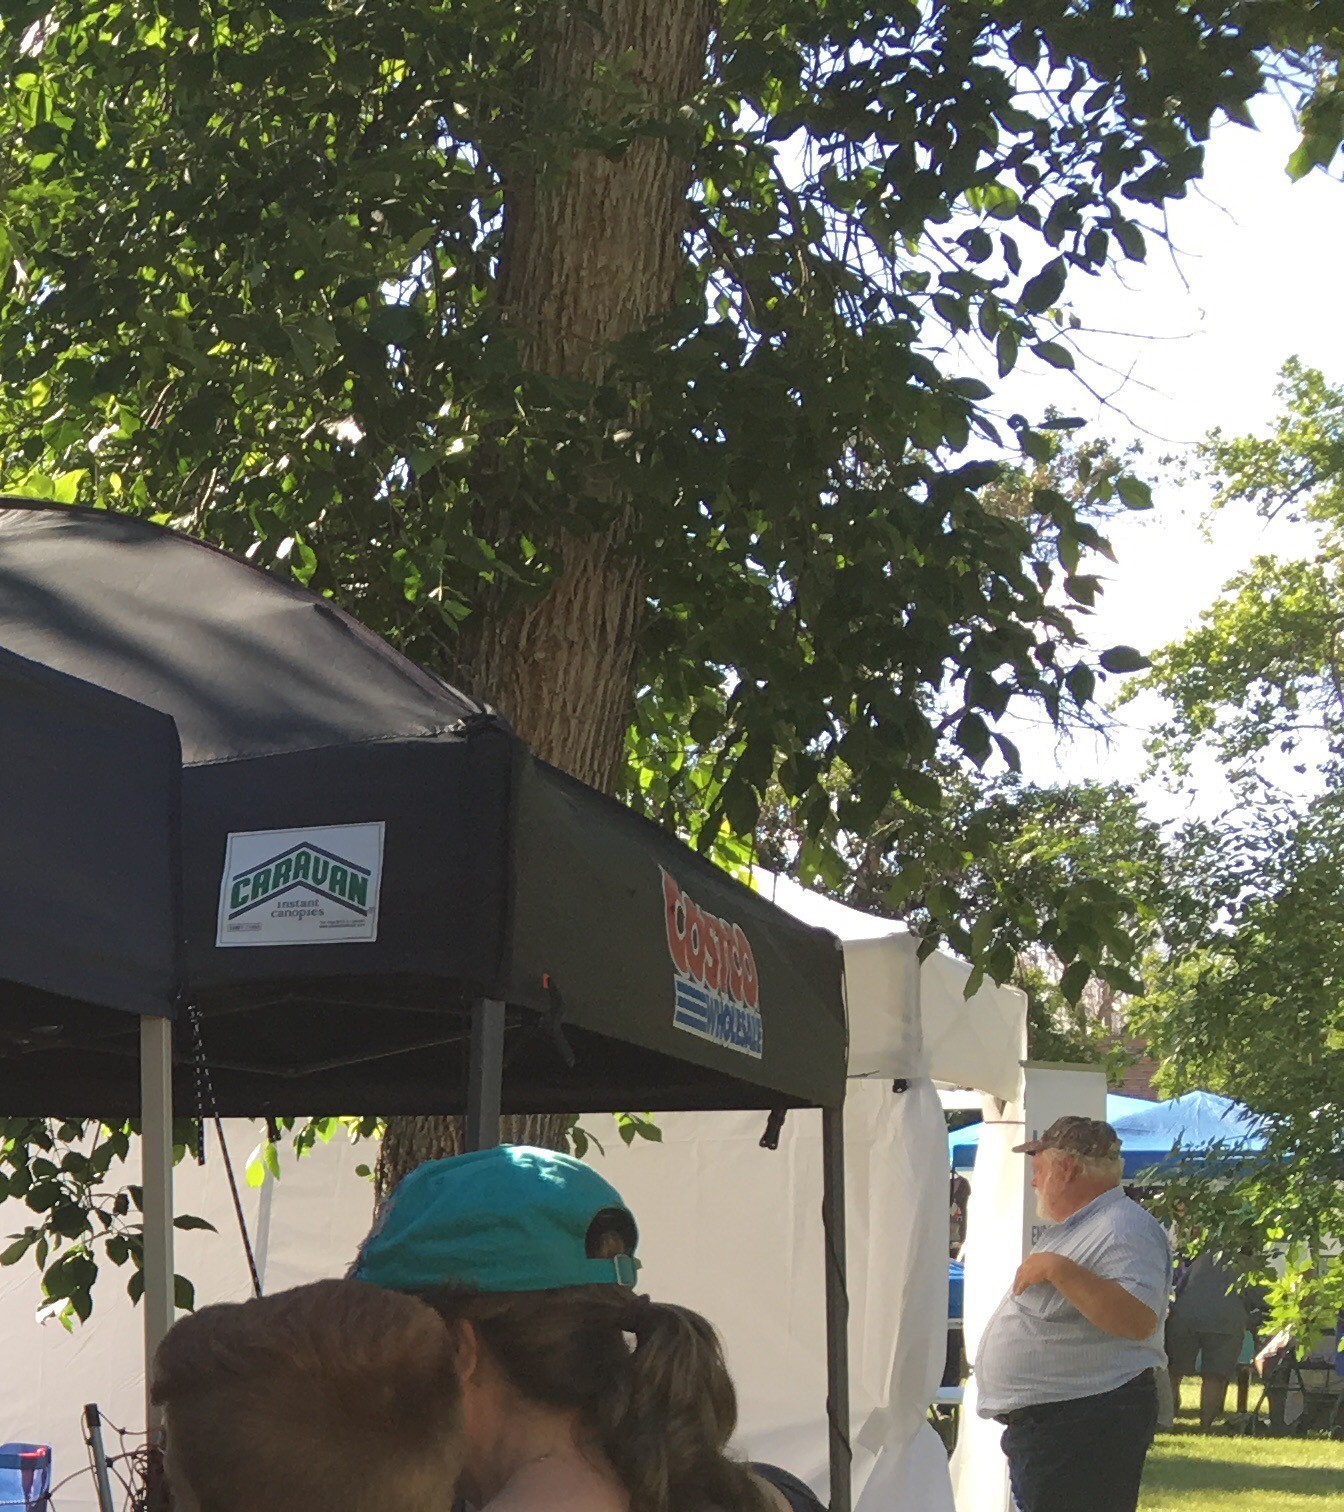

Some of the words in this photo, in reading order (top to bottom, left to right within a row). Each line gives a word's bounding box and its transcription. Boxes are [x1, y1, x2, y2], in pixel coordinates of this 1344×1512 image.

[230, 850, 369, 908] CARAVAN
[276, 898, 321, 910] instant
[270, 908, 325, 921] canopies
[660, 867, 760, 1011] COSTCO
[706, 996, 763, 1055] WHOLESALE
